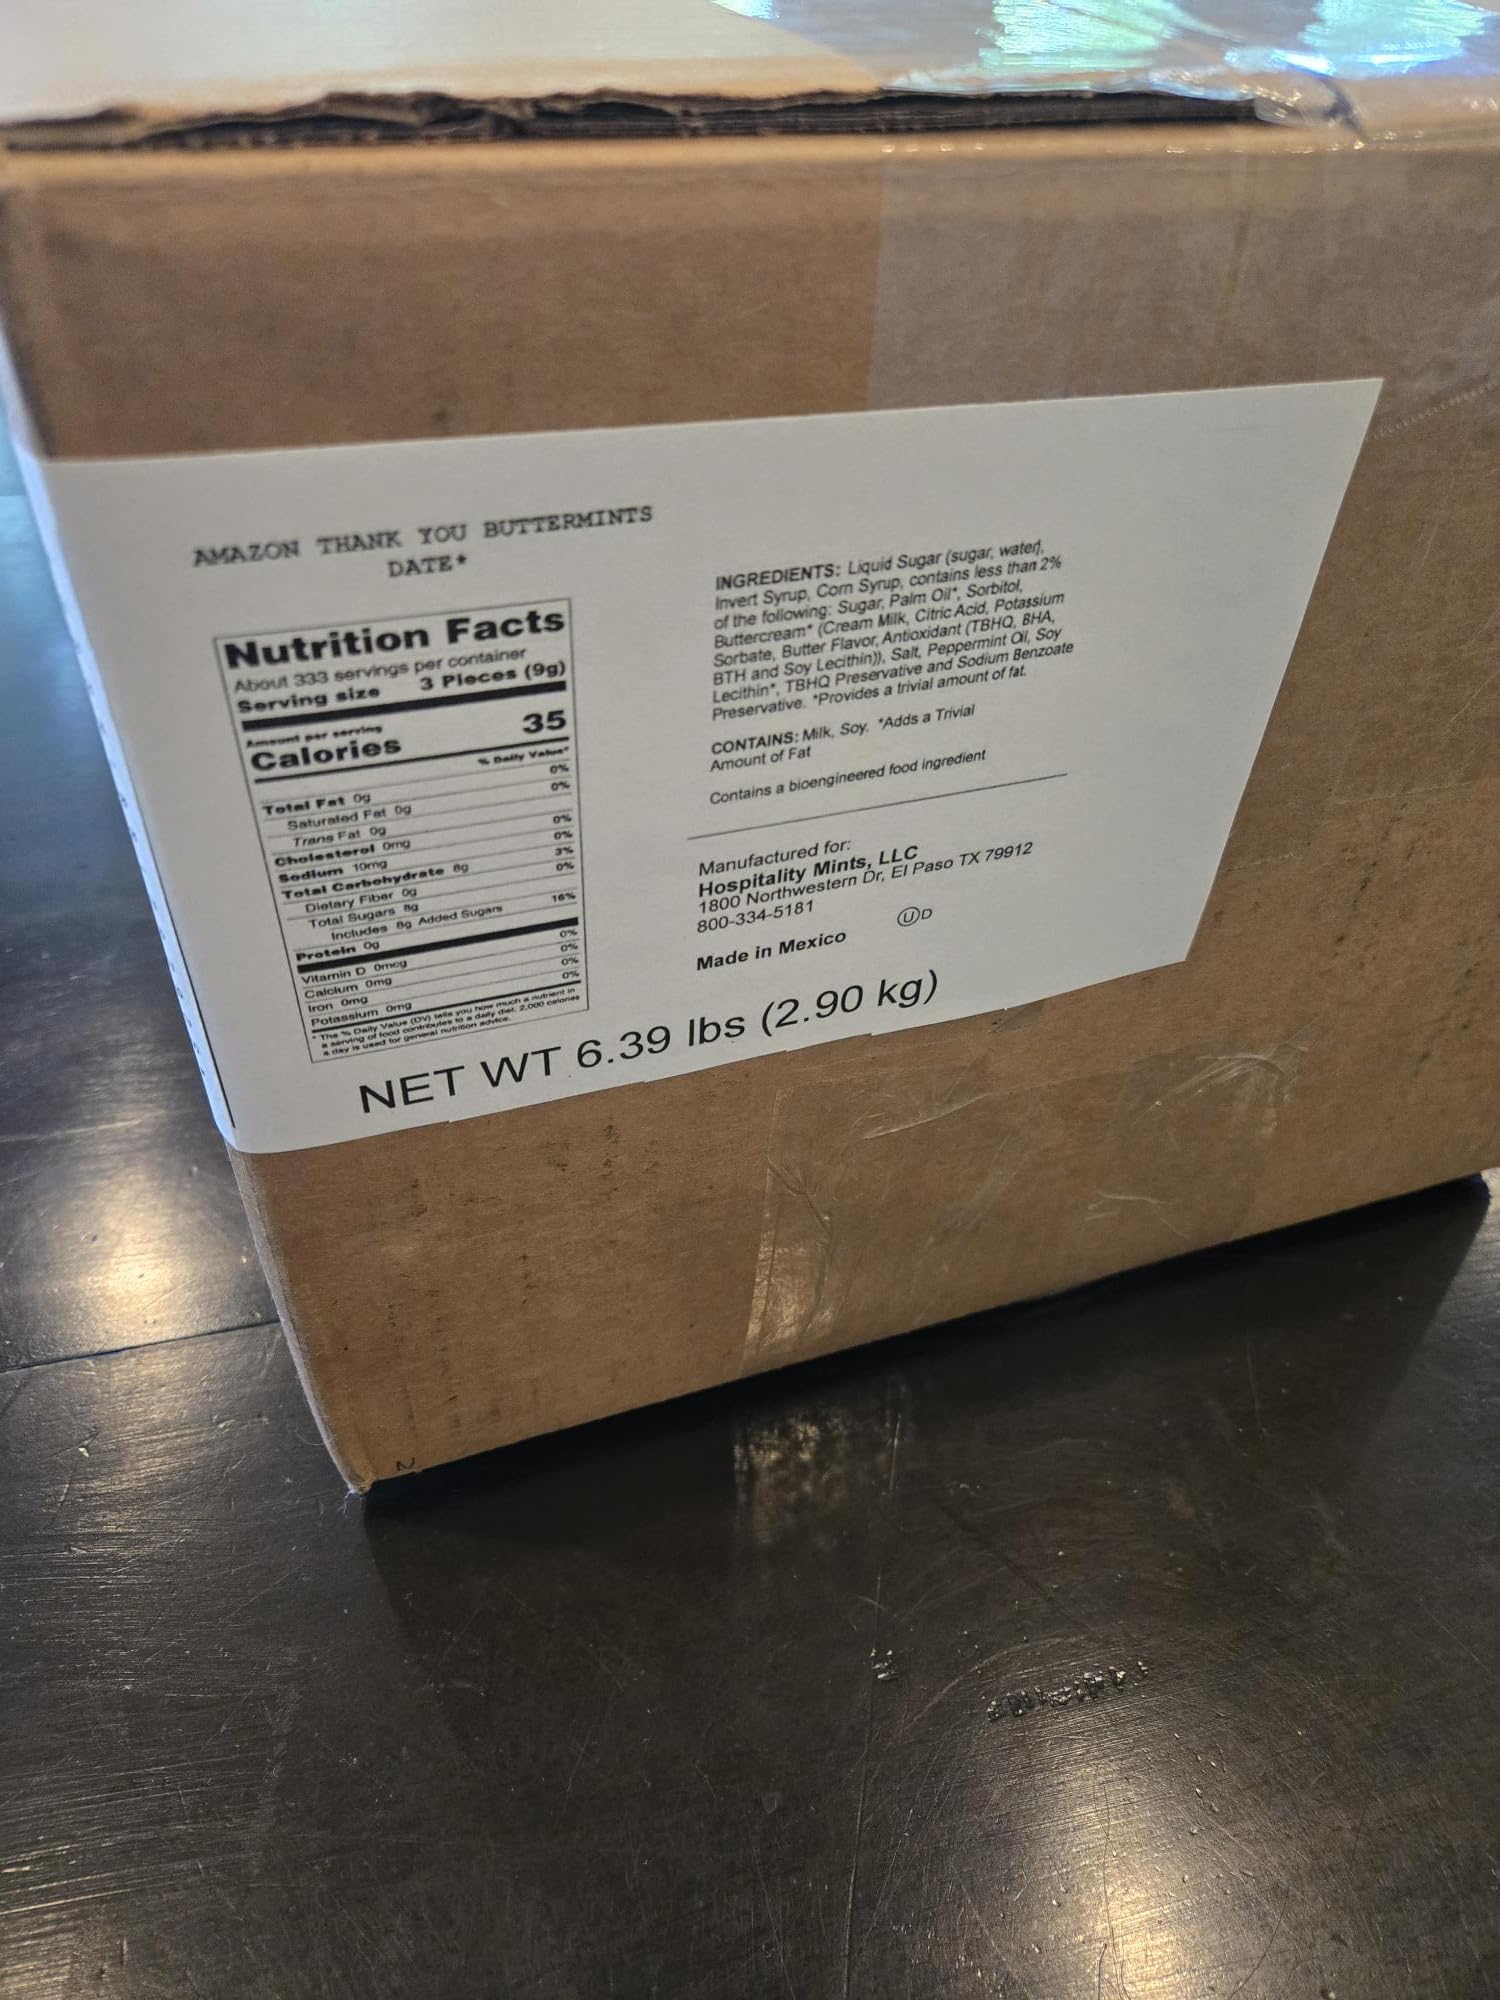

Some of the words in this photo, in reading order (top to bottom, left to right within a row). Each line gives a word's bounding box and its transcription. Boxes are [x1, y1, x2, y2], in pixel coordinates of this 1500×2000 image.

[193, 540, 300, 567] AMAZON
[316, 530, 401, 555] THANK
[417, 523, 468, 545] YOU
[483, 505, 653, 538] BUTTERMINTS
[715, 563, 841, 591] INGREDIENTS:
[847, 556, 893, 576] Liquid
[896, 552, 943, 571] Sugar
[715, 593, 759, 610] Invert
[762, 589, 810, 607] Syrup,
[858, 577, 904, 595] Syrup,
[909, 568, 970, 587] contains
[974, 564, 1003, 579] less
[1007, 560, 1038, 575] than
[1039, 555, 1062, 571] 2%
[714, 614, 730, 630] of
[732, 613, 757, 628] the
[761, 605, 831, 624] following:
[837, 598, 885, 616] Sugar,
[889, 592, 927, 608] Palm
[966, 578, 1023, 599] Sorbitol,
[817, 617, 874, 638] (Cream
[914, 608, 952, 623] Citric
[953, 601, 989, 618] Acid,
[994, 593, 1065, 613] Potassium
[223, 627, 430, 669] Nutrition
[446, 610, 565, 645] Facts
[713, 648, 776, 668] Sorbate,
[781, 642, 827, 659] Butter
[830, 635, 879, 652] Flavor,
[881, 622, 962, 645] Antioxidant
[965, 614, 1017, 637] (TBHQ,
[1021, 609, 1055, 627] BHA,
[713, 668, 747, 686] BTH
[750, 664, 780, 681] and
[783, 661, 812, 677] Soy
[890, 646, 922, 662] Salt,
[927, 633, 1007, 657] Peppermint
[1010, 630, 1030, 645] Oil,
[1035, 627, 1062, 642] Soy
[234, 675, 289, 693] About
[293, 670, 329, 687] 333
[333, 663, 410, 682] servings
[413, 658, 443, 675] per
[447, 648, 527, 669] container
[237, 694, 328, 714] Serving
[335, 687, 380, 702] size
[420, 676, 434, 691] 3
[441, 669, 518, 689] Pieces
[524, 660, 566, 681] (9g)
[712, 698, 807, 721] Preservative.
[883, 685, 893, 697] a
[897, 677, 934, 695] trivial
[936, 669, 990, 689] amount
[991, 666, 1007, 681] of
[1008, 663, 1029, 678] fat.
[785, 674, 831, 693] TBHQ
[835, 664, 923, 686] Preservative
[926, 657, 954, 674] and
[956, 652, 1009, 669] Sodium
[1012, 642, 1074, 661] Benzoate
[250, 739, 402, 771] Calories
[522, 709, 567, 734] 35
[711, 731, 799, 755] CONTAINS:
[922, 712, 931, 724] a
[935, 703, 976, 721] Trivial
[709, 786, 772, 805] Contains
[775, 784, 785, 795] a
[788, 765, 886, 792] bioengineered
[888, 759, 919, 776] food
[921, 749, 987, 771] ingredient
[710, 752, 766, 772] Amount
[770, 748, 785, 763] of
[788, 745, 811, 761] Fat
[262, 800, 311, 816] Total
[315, 796, 345, 809] Fat
[287, 811, 359, 831] Saturated
[362, 808, 386, 820] Fat
[274, 843, 375, 867] Cholesterol
[382, 839, 411, 851] 0mg
[293, 834, 335, 847] Trans
[337, 829, 361, 841] Fat
[699, 843, 818, 877] Manufactured
[824, 839, 851, 857] for:
[278, 867, 344, 883] Sodium
[353, 860, 388, 872] 10mg
[331, 868, 445, 892] Carbohydrate
[699, 867, 807, 898] Hospitality
[813, 856, 872, 877] Mints,
[878, 845, 919, 866] LLC
[699, 895, 741, 914] 1800
[746, 876, 858, 906] Northwestern
[862, 870, 885, 884] Dr,
[891, 864, 908, 879] El
[912, 859, 954, 875] Paso
[958, 850, 981, 867] TX
[985, 841, 1033, 862] 79912
[305, 898, 355, 913] Dietary
[359, 892, 393, 905] Fiber
[309, 915, 344, 929] Total
[347, 908, 396, 922] Sugars
[330, 925, 388, 941] Includes
[418, 911, 458, 926] Added
[460, 905, 503, 919] Sugars
[552, 892, 577, 902] 16%
[697, 899, 813, 934] 800-334-5181
[295, 946, 357, 962] Protein
[300, 970, 352, 985] Vitamin
[355, 966, 367, 976] D
[373, 960, 408, 972] 0mcg
[304, 984, 359, 999] Calcium
[364, 977, 393, 988] 0mg
[560, 942, 579, 953] 0%
[696, 950, 749, 971] Made
[755, 945, 772, 960] in
[778, 932, 847, 955] Mexico
[307, 1003, 334, 1013] Iron
[340, 996, 369, 1007] 0mg
[560, 956, 580, 967] 0%
[310, 1009, 379, 1027] Potassium
[385, 1002, 412, 1013] 0mg
[561, 969, 580, 980] 0%
[359, 1065, 465, 1114] NET
[479, 1046, 562, 1088] WT
[577, 1025, 671, 1068] 6.39
[688, 1016, 745, 1047] lbs
[761, 984, 864, 1037] (2.90
[877, 969, 938, 1009] kg)
